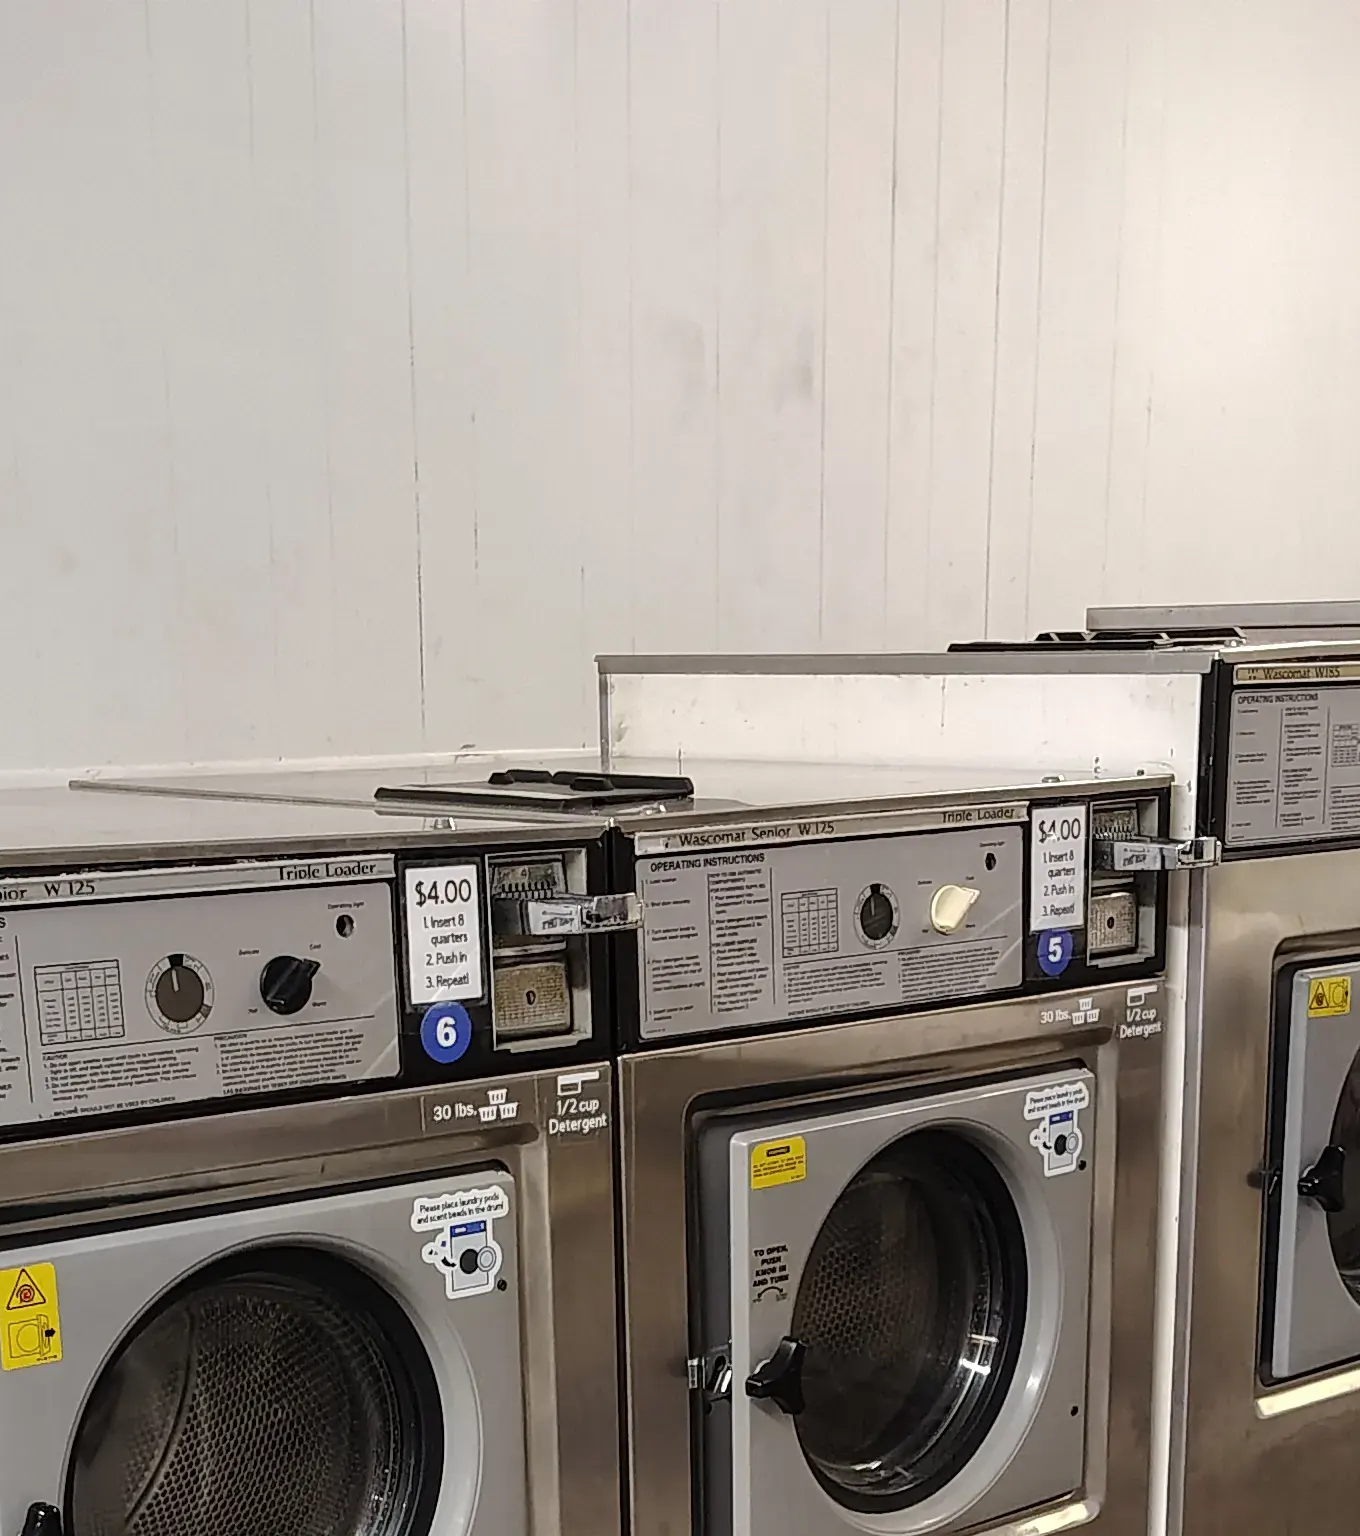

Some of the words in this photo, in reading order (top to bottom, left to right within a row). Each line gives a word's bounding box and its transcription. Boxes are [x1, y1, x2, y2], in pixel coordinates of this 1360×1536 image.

[1262, 667, 1310, 680] Wascomat
[1237, 693, 1274, 705] OPERATING
[941, 811, 973, 823] Triple
[977, 807, 1015, 821] Loader
[678, 830, 746, 847] Wascomat
[751, 826, 792, 840] Senior
[797, 823, 811, 836] W
[1038, 817, 1081, 844] $4.00
[650, 858, 702, 872] OPERATING
[703, 852, 765, 867] INSTRUCTIONS
[1048, 852, 1068, 863] Insert
[279, 863, 320, 881] Triple
[325, 860, 377, 878] Loader
[1047, 867, 1076, 881] quarters
[43, 881, 61, 897] W
[68, 880, 96, 896] 125
[414, 878, 472, 908] $4.00
[1051, 886, 1067, 896] Push
[430, 915, 457, 928] Insert
[457, 914, 465, 927] 8
[430, 933, 469, 947] quarters
[1048, 937, 1062, 962] 5
[425, 953, 434, 966] 2.
[435, 953, 458, 965] Push
[458, 951, 468, 964] in
[425, 976, 435, 989] 3.
[435, 973, 470, 990] Repeat!
[1040, 1011, 1054, 1024] 30
[1055, 1009, 1071, 1021] lbs.
[1126, 1009, 1140, 1022] 1/2
[1141, 1009, 1157, 1022] cup
[436, 1016, 457, 1048] 6
[1119, 1021, 1162, 1039] Detergent
[432, 1106, 452, 1121] 30
[454, 1101, 477, 1117] lbs.
[556, 1100, 575, 1116] 1/2
[578, 1100, 599, 1115] cup
[549, 1113, 607, 1135] Detergent
[419, 1203, 441, 1213] Please
[441, 1200, 458, 1211] place
[459, 1197, 483, 1207] laundry
[484, 1192, 500, 1204] pods
[417, 1216, 428, 1225] and
[429, 1213, 448, 1223] scent
[448, 1208, 467, 1219] beads
[753, 1249, 765, 1257] TO
